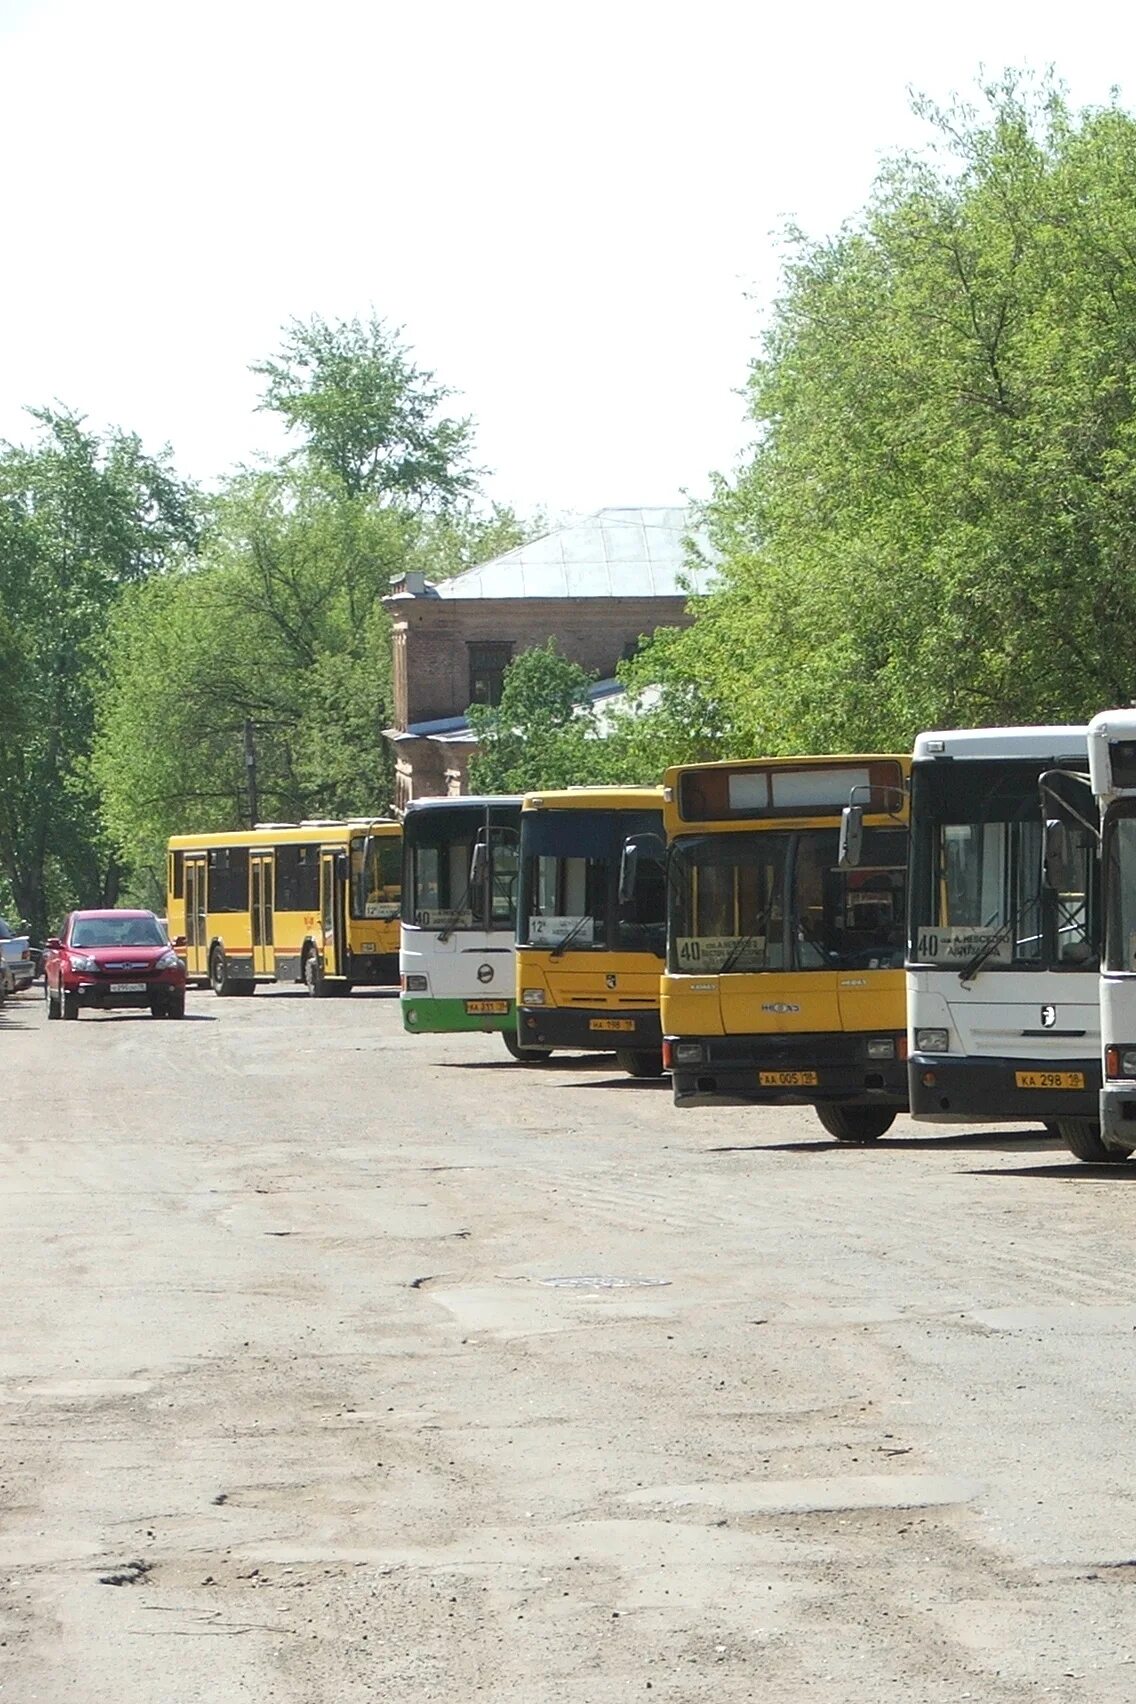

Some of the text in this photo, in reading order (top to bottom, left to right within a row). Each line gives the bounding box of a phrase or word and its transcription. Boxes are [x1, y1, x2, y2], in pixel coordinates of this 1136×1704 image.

[681, 942, 700, 961] 40
[919, 935, 938, 957] 40
[780, 1073, 799, 1084] 005
[1022, 1076, 1035, 1086] КА
[1040, 1074, 1062, 1086] 298
